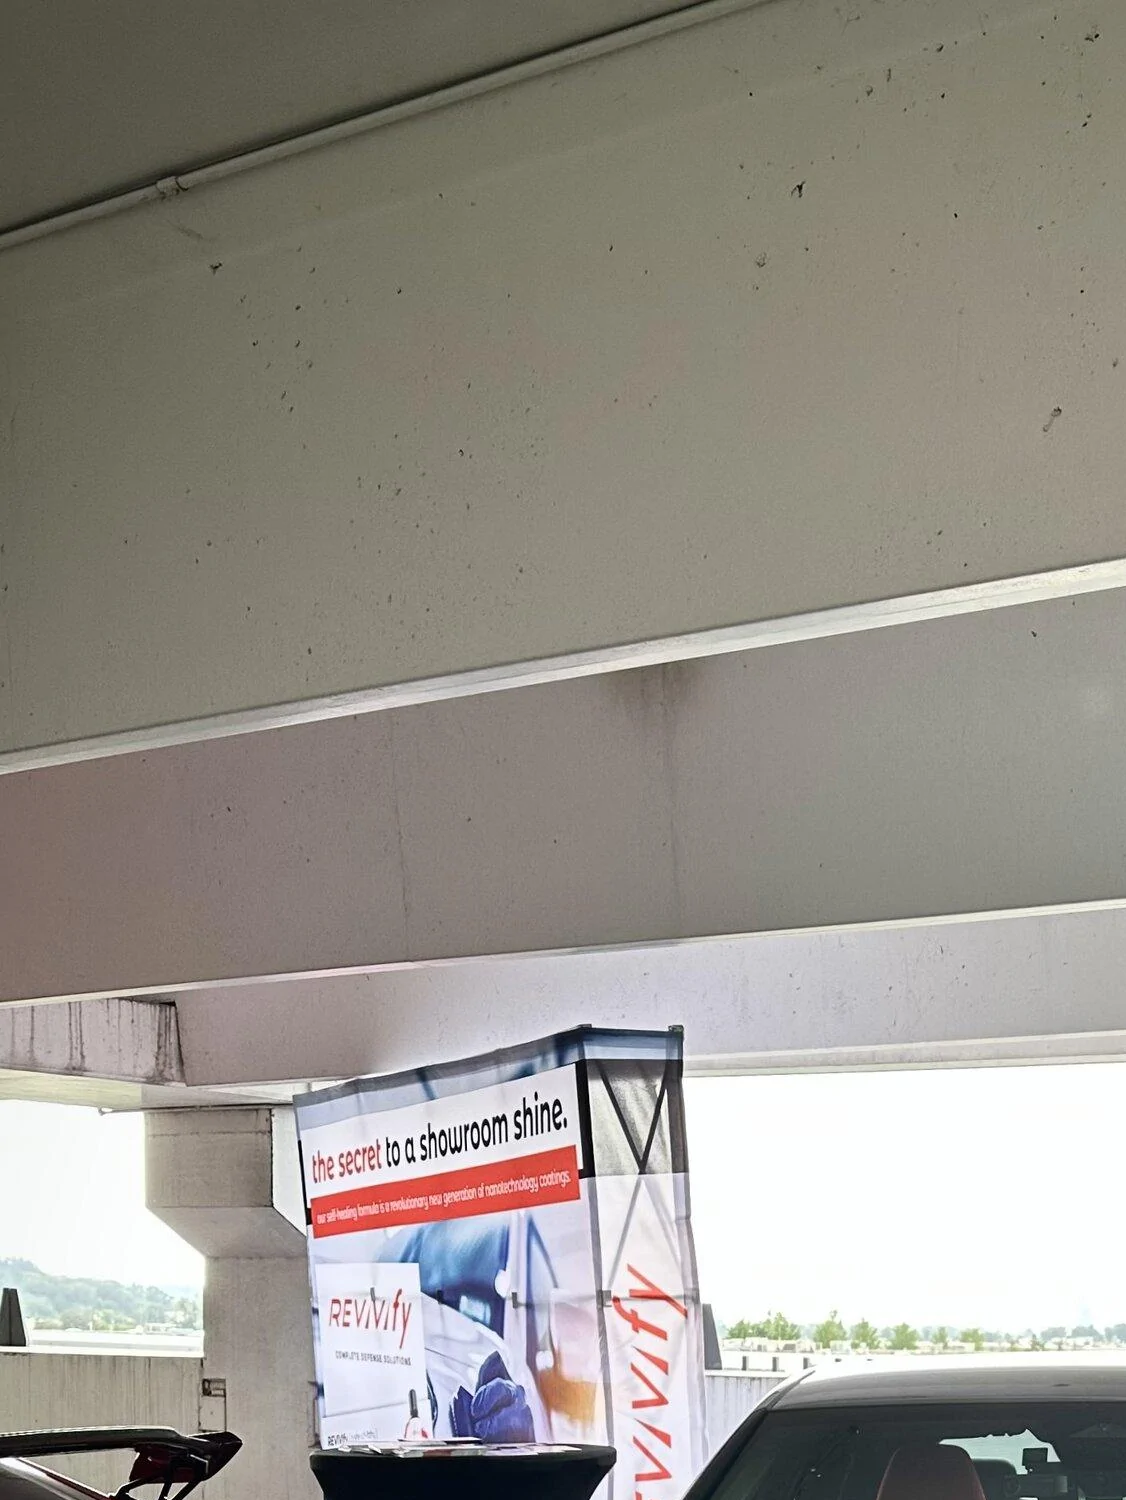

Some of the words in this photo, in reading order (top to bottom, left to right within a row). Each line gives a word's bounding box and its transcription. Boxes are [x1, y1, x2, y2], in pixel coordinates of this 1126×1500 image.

[312, 1150, 335, 1184] the
[338, 1138, 382, 1178] secret
[386, 1136, 401, 1168] to
[404, 1137, 416, 1164] a
[420, 1113, 509, 1161] showroom
[513, 1091, 568, 1140] shine.
[443, 1185, 477, 1207] generation
[485, 1174, 539, 1196] nanotechnology
